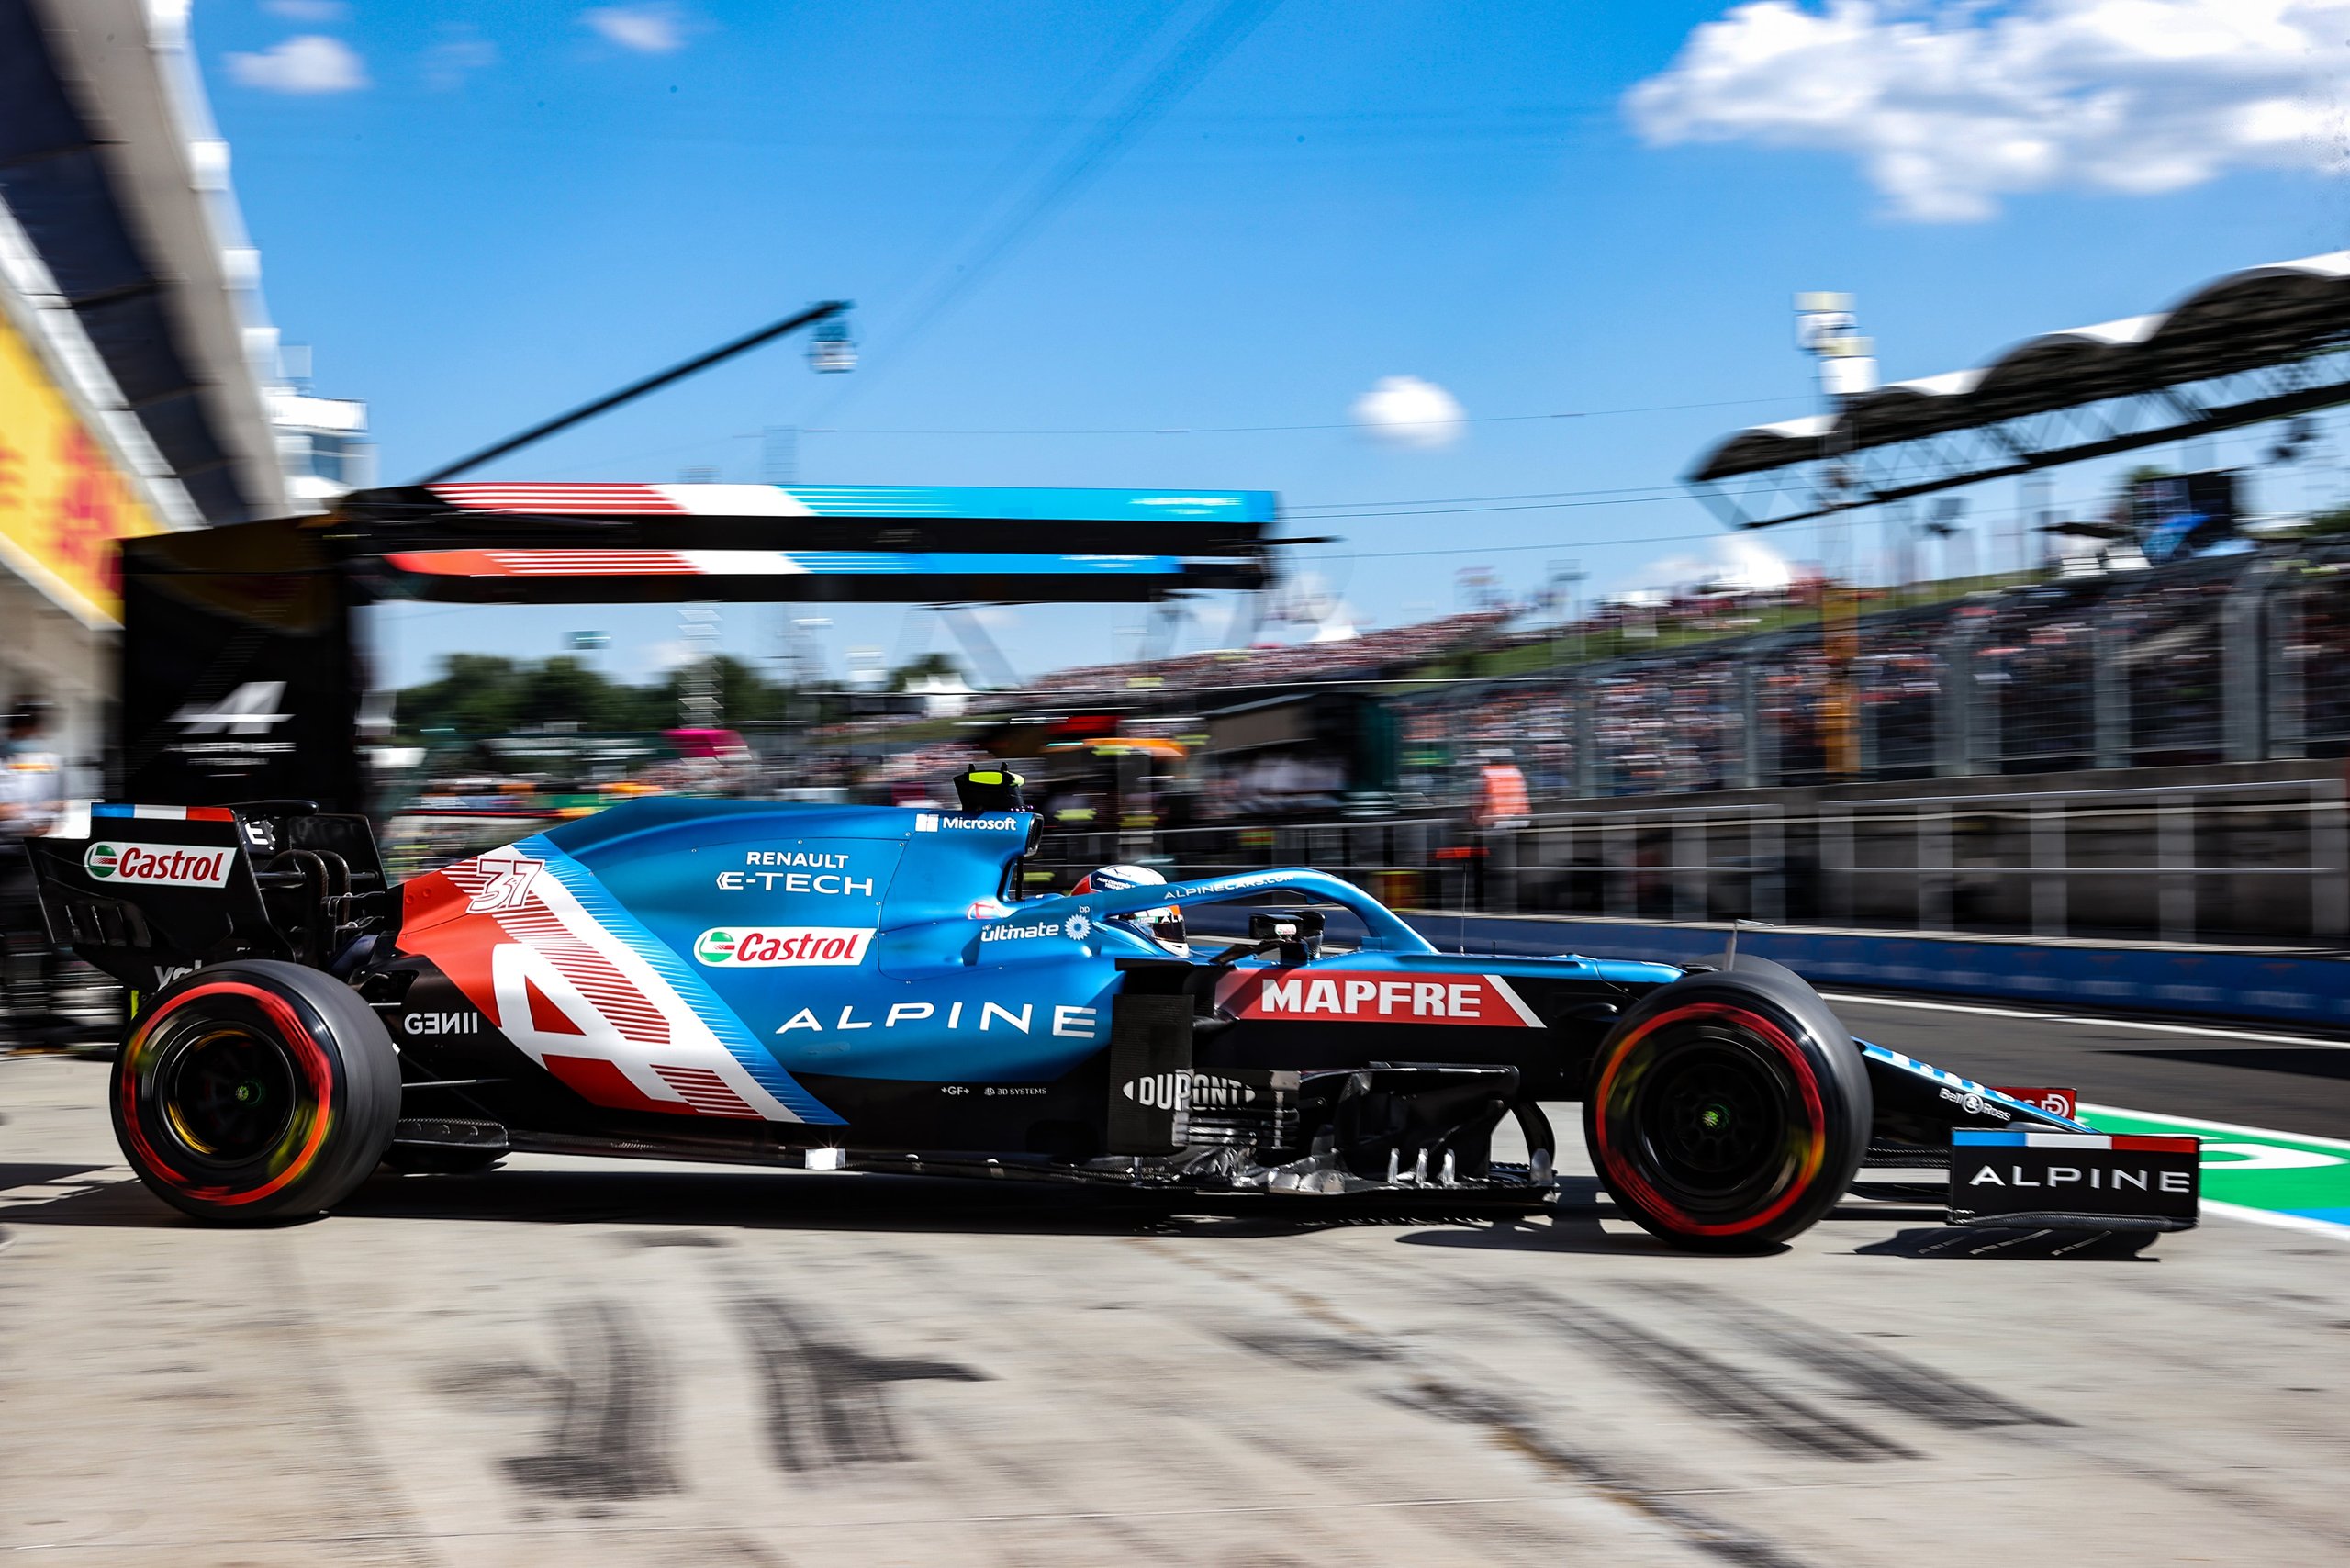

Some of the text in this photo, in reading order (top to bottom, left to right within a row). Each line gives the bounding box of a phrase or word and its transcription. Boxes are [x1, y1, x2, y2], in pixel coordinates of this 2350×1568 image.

[943, 816, 1017, 831] Microsoft
[119, 847, 224, 882] Castrol
[746, 851, 849, 868] RENAULT
[716, 871, 873, 897] E-TECH
[1079, 904, 1090, 913] bp
[980, 922, 1060, 942] ultimate
[736, 931, 860, 962] Castrol
[1261, 977, 1483, 1019] MAPFRE
[775, 1002, 1097, 1039] ALPINE
[1010, 1087, 1047, 1095] SYSTEMS
[1139, 1072, 1242, 1112] DUPONT
[1939, 1087, 1963, 1104] Bell
[1969, 1164, 2190, 1193] ALPINE
